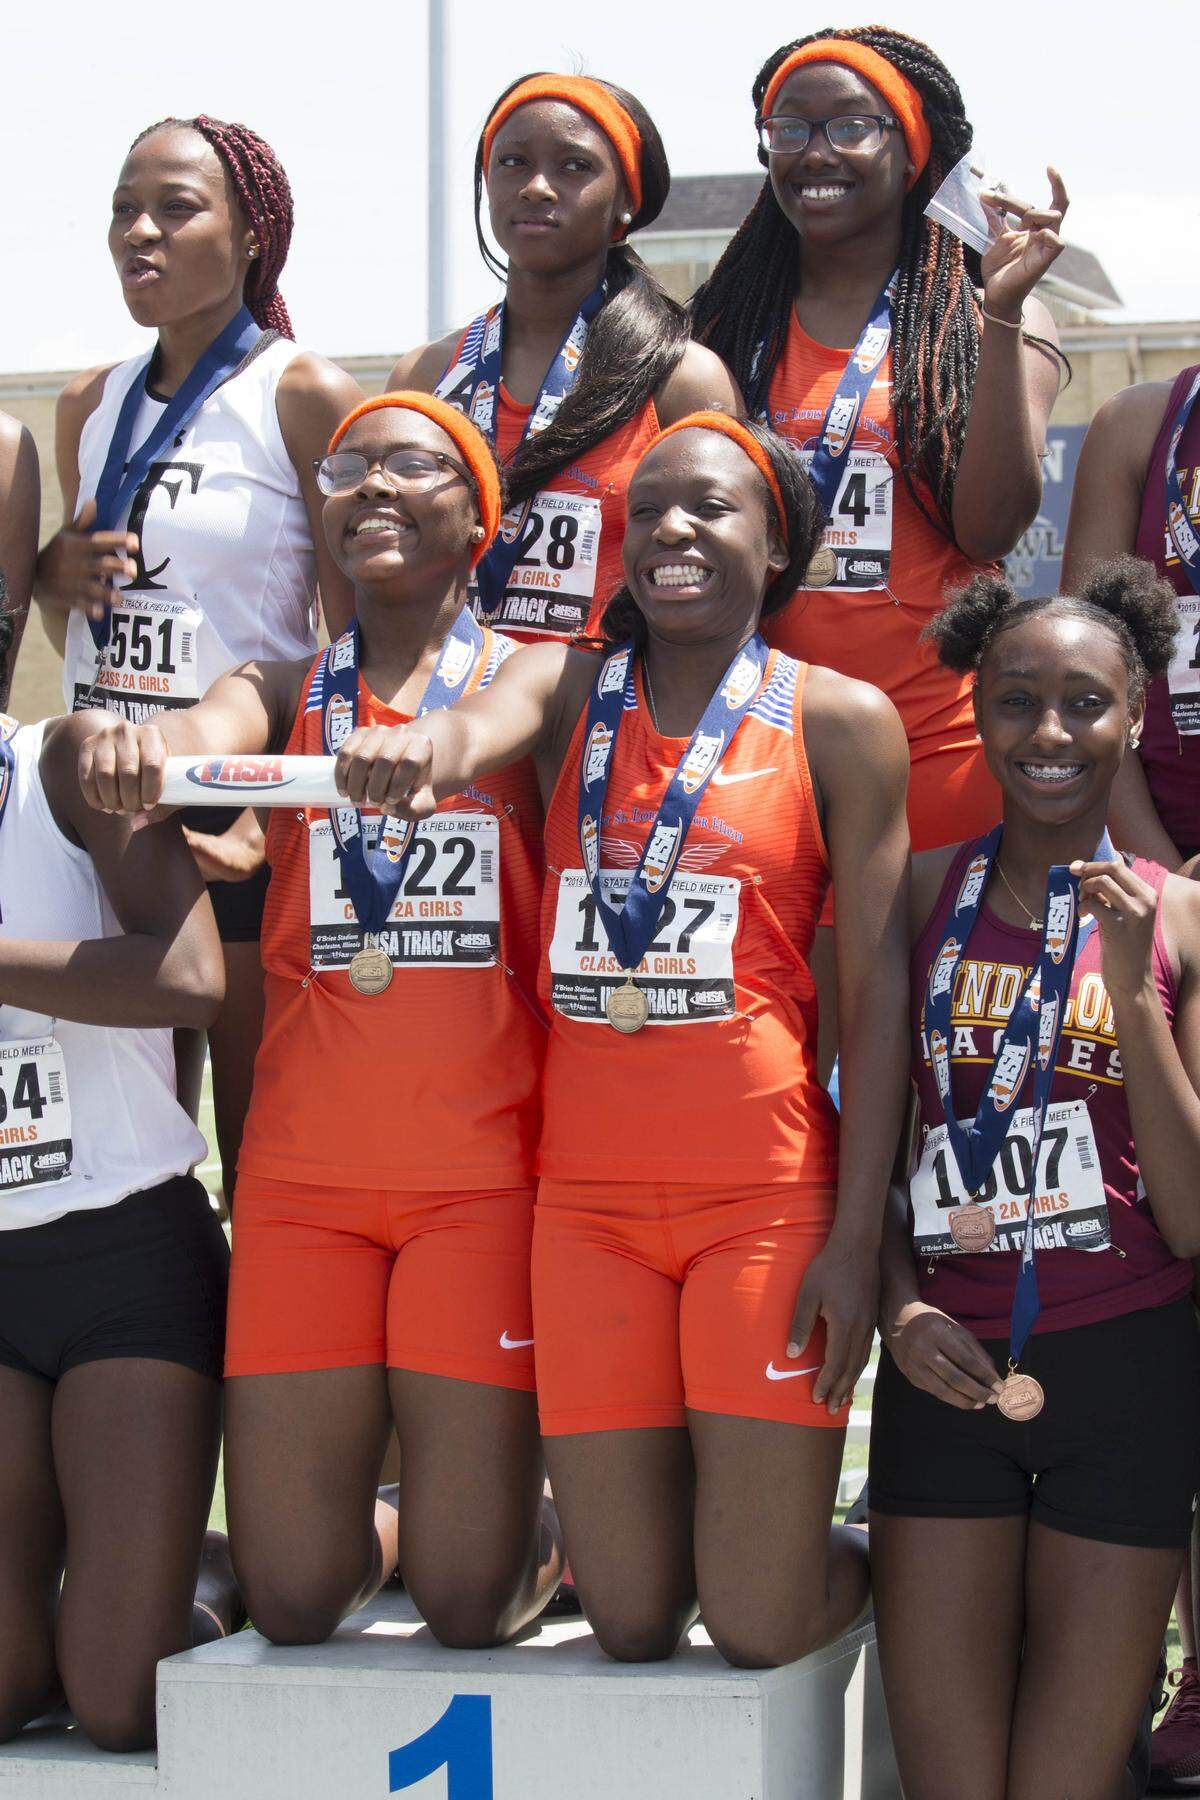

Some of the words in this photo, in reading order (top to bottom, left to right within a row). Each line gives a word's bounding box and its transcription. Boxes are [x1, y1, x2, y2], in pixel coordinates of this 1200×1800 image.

[853, 458, 877, 467] MEET
[541, 500, 564, 509] FIELD
[565, 501, 583, 512] MEE
[521, 571, 562, 588] GIRLS
[125, 600, 142, 611] TRACK
[149, 602, 169, 613] FIELD
[169, 604, 187, 615] MEE
[503, 596, 548, 623] TRACK
[122, 673, 136, 689] 2A
[138, 674, 170, 693] GIRLS
[421, 822, 428, 832] &
[429, 822, 456, 833] FIELD
[456, 822, 482, 831] MEET
[603, 877, 630, 887] STATE
[671, 881, 697, 892] FIELD
[698, 884, 726, 894] MEET
[395, 901, 414, 918] 2A
[419, 900, 463, 918] GIRLS
[402, 930, 454, 956] TRACK
[653, 957, 697, 975] GIRLS
[21, 1045, 46, 1056] MEET
[1049, 1110, 1072, 1121] MEET
[1000, 1203, 1021, 1220] 2A
[388, 1694, 494, 1800] 1
